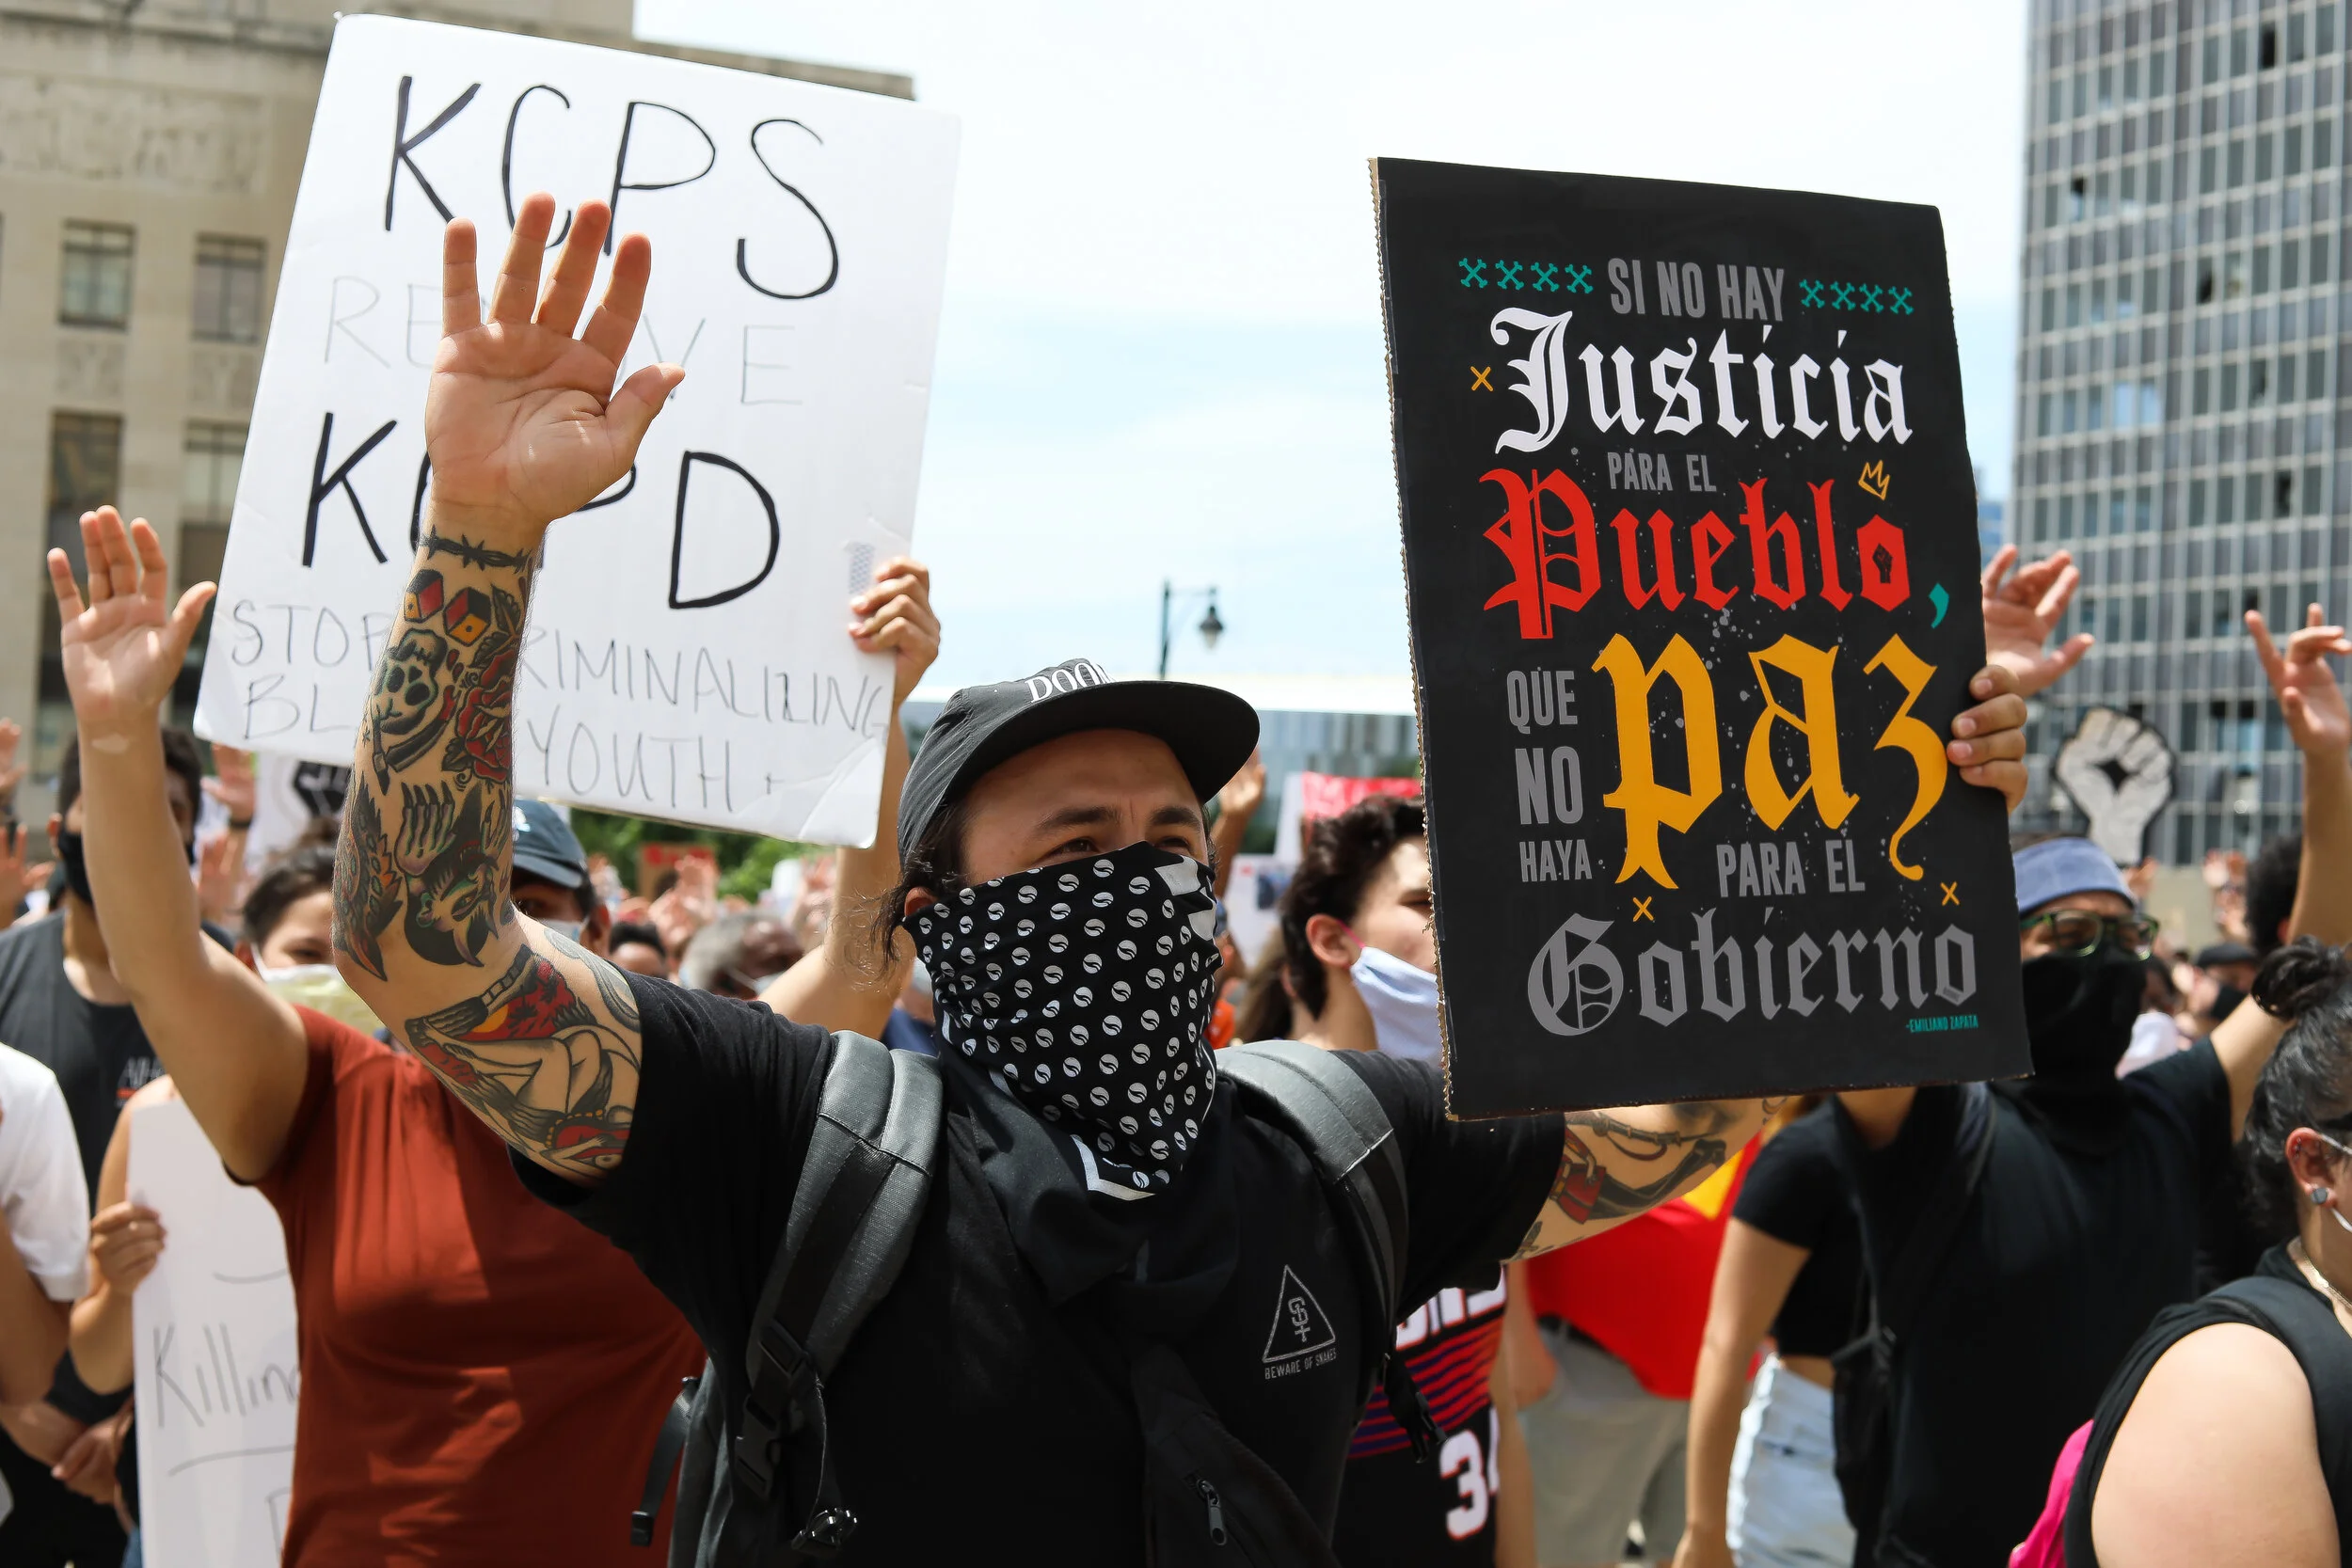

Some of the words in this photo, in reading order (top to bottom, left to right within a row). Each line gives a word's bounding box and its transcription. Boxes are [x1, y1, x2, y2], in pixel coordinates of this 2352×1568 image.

[385, 74, 839, 300] KCPS
[1608, 258, 1645, 315] SI
[1656, 261, 1706, 319] NO
[1717, 264, 1785, 322] HAY
[326, 276, 803, 405] REVE
[1608, 451, 1674, 491] PARA
[1686, 453, 1717, 492] EL
[523, 625, 889, 744] RIMINALIZING
[1506, 669, 1579, 734] QUE
[527, 704, 734, 813] YOUTH
[1516, 746, 1583, 825] NO
[1519, 839, 1593, 882] HAYA
[1717, 841, 1805, 897] PARA
[1826, 839, 1866, 893] EL
[1949, 1014, 1979, 1031] ZAPATA
[152, 1322, 299, 1429] Killin
[1264, 1359, 1301, 1381] BEWARE
[1304, 1355, 1313, 1370] OF
